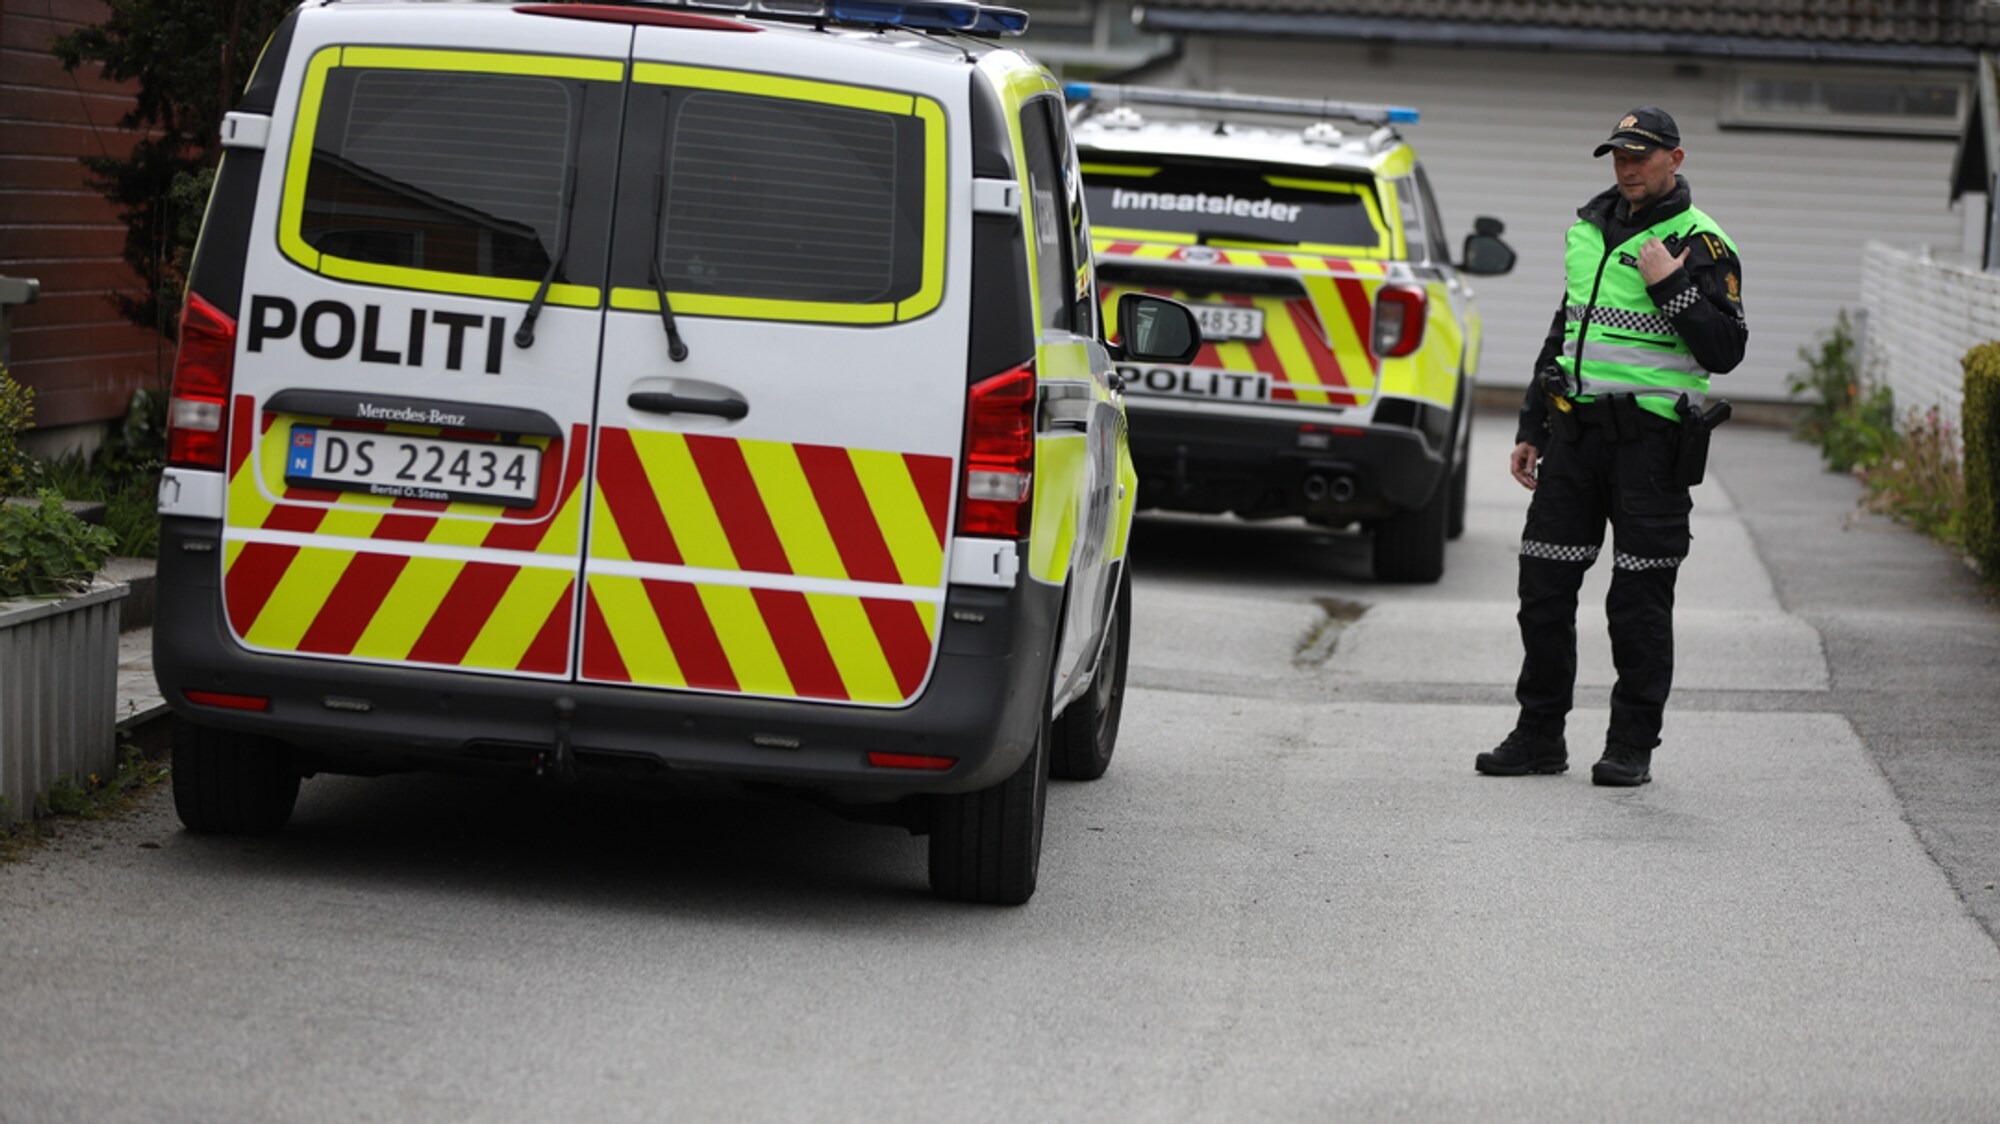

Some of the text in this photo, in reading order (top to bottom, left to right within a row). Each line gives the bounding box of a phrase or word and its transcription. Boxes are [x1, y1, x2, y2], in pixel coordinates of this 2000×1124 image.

[1112, 187, 1301, 223] Innsatsleder
[246, 294, 506, 375] POLITI
[1117, 366, 1266, 399] POLITI
[357, 402, 466, 426] Mercedes-Benz
[295, 457, 307, 470] N
[323, 436, 526, 490] DS 22434
[370, 483, 402, 496] Bertel
[418, 488, 449, 500] Steen
